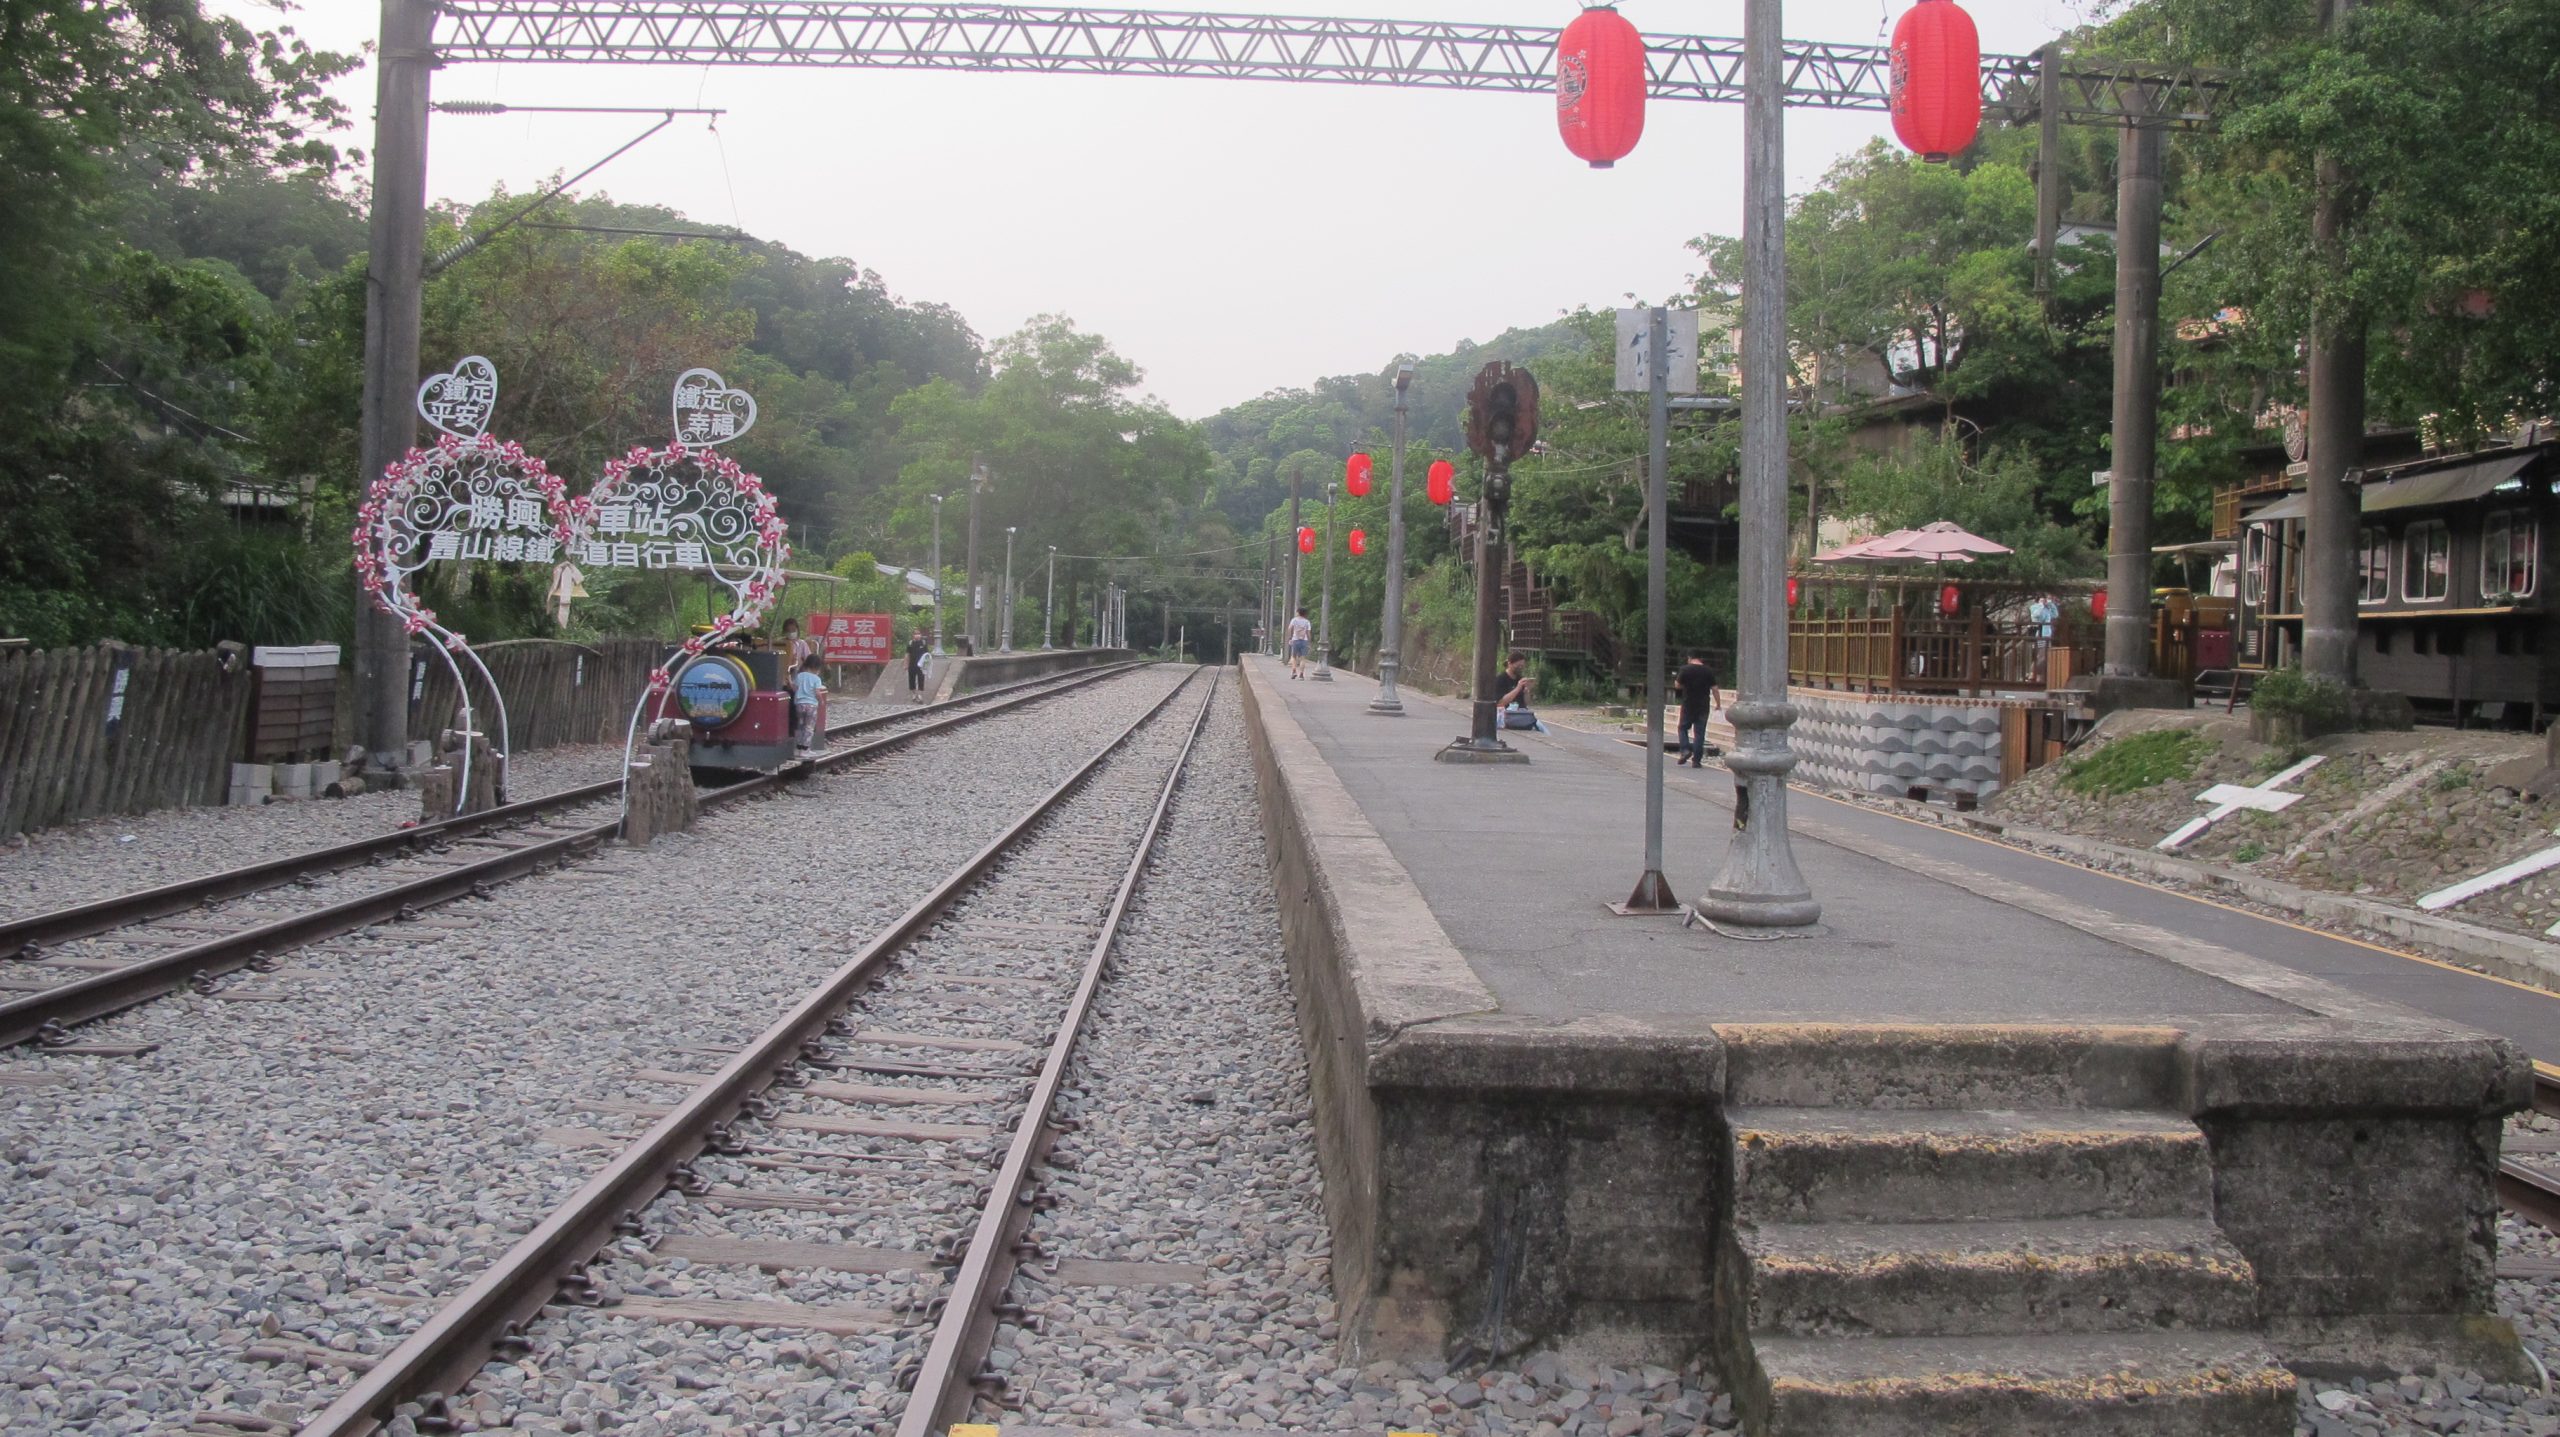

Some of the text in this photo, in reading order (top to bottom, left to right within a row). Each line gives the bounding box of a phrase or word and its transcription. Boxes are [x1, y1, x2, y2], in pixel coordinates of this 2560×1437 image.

[677, 386, 725, 411] 鐵定
[430, 403, 479, 428] 平安
[688, 412, 735, 436] 幸福
[828, 619, 876, 635] 泉宏
